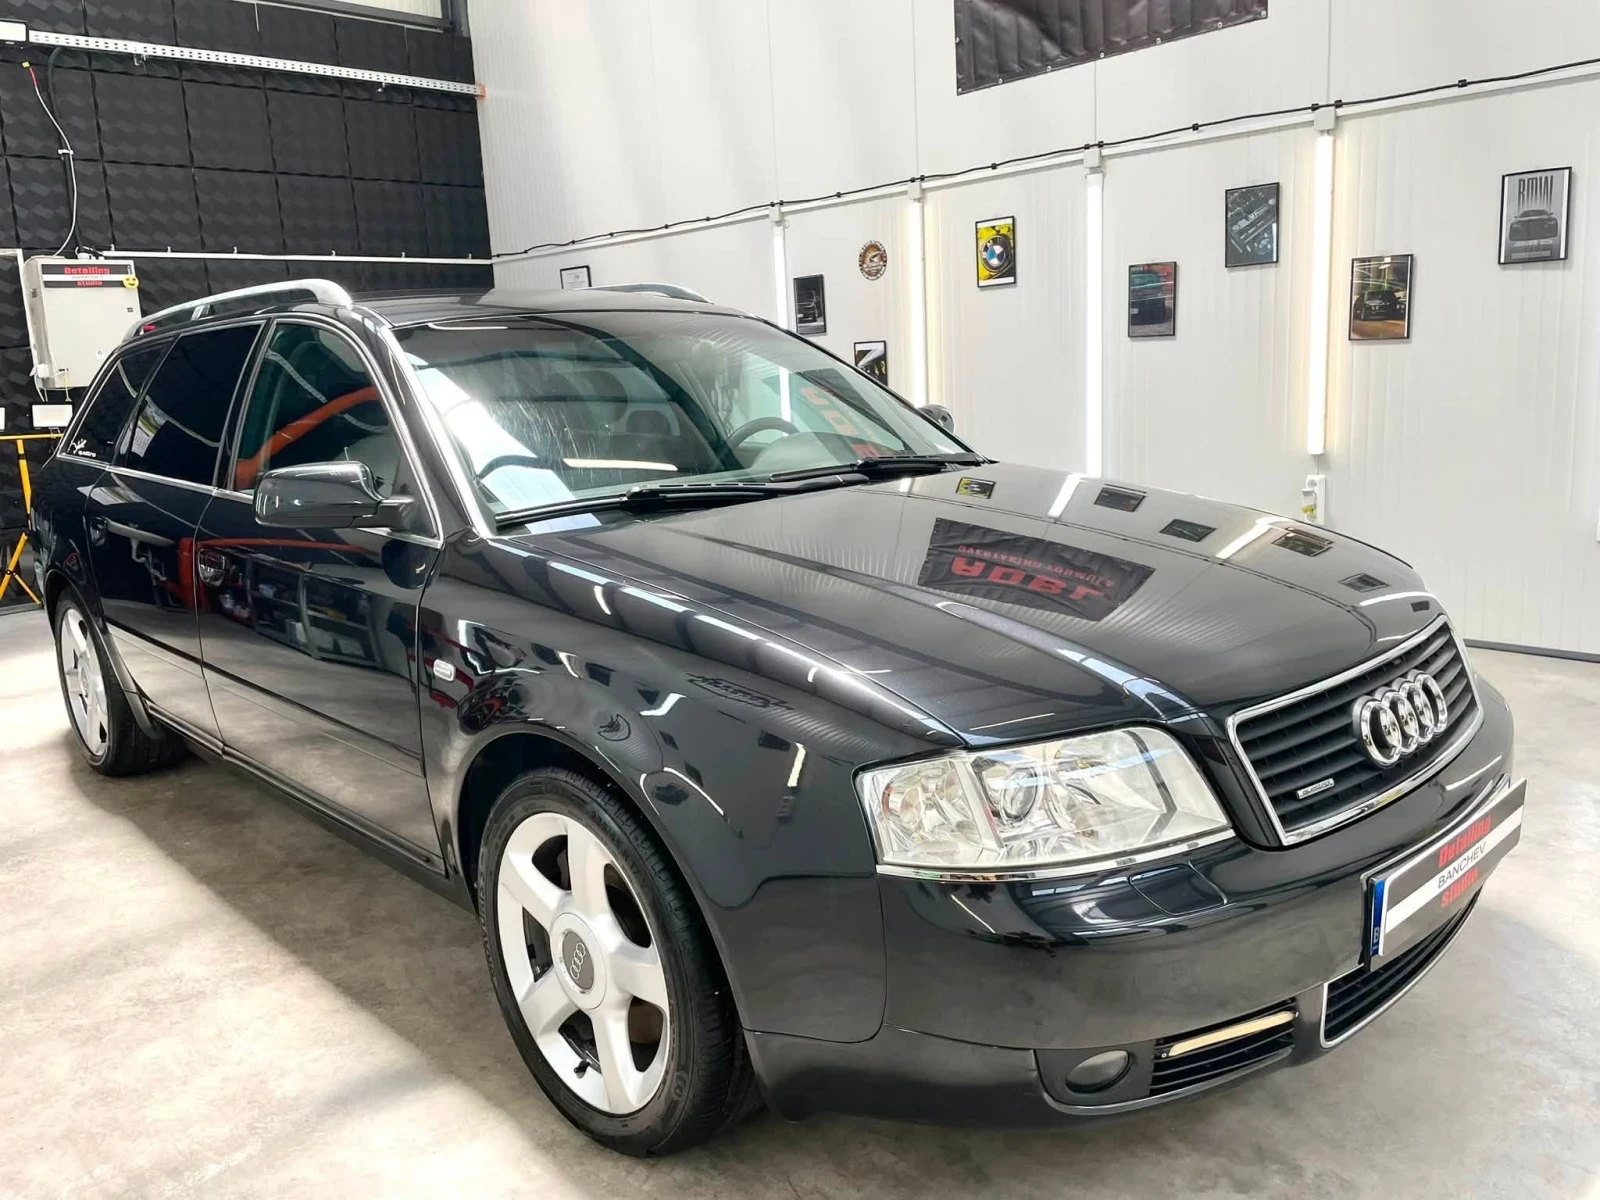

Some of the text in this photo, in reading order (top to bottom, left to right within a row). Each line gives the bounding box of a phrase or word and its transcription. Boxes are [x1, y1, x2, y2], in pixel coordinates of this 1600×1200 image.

[64, 266, 110, 275] Detailing
[1438, 814, 1492, 868] Detailing
[1437, 841, 1487, 890] BANCHEV
[1440, 867, 1479, 909] studio
